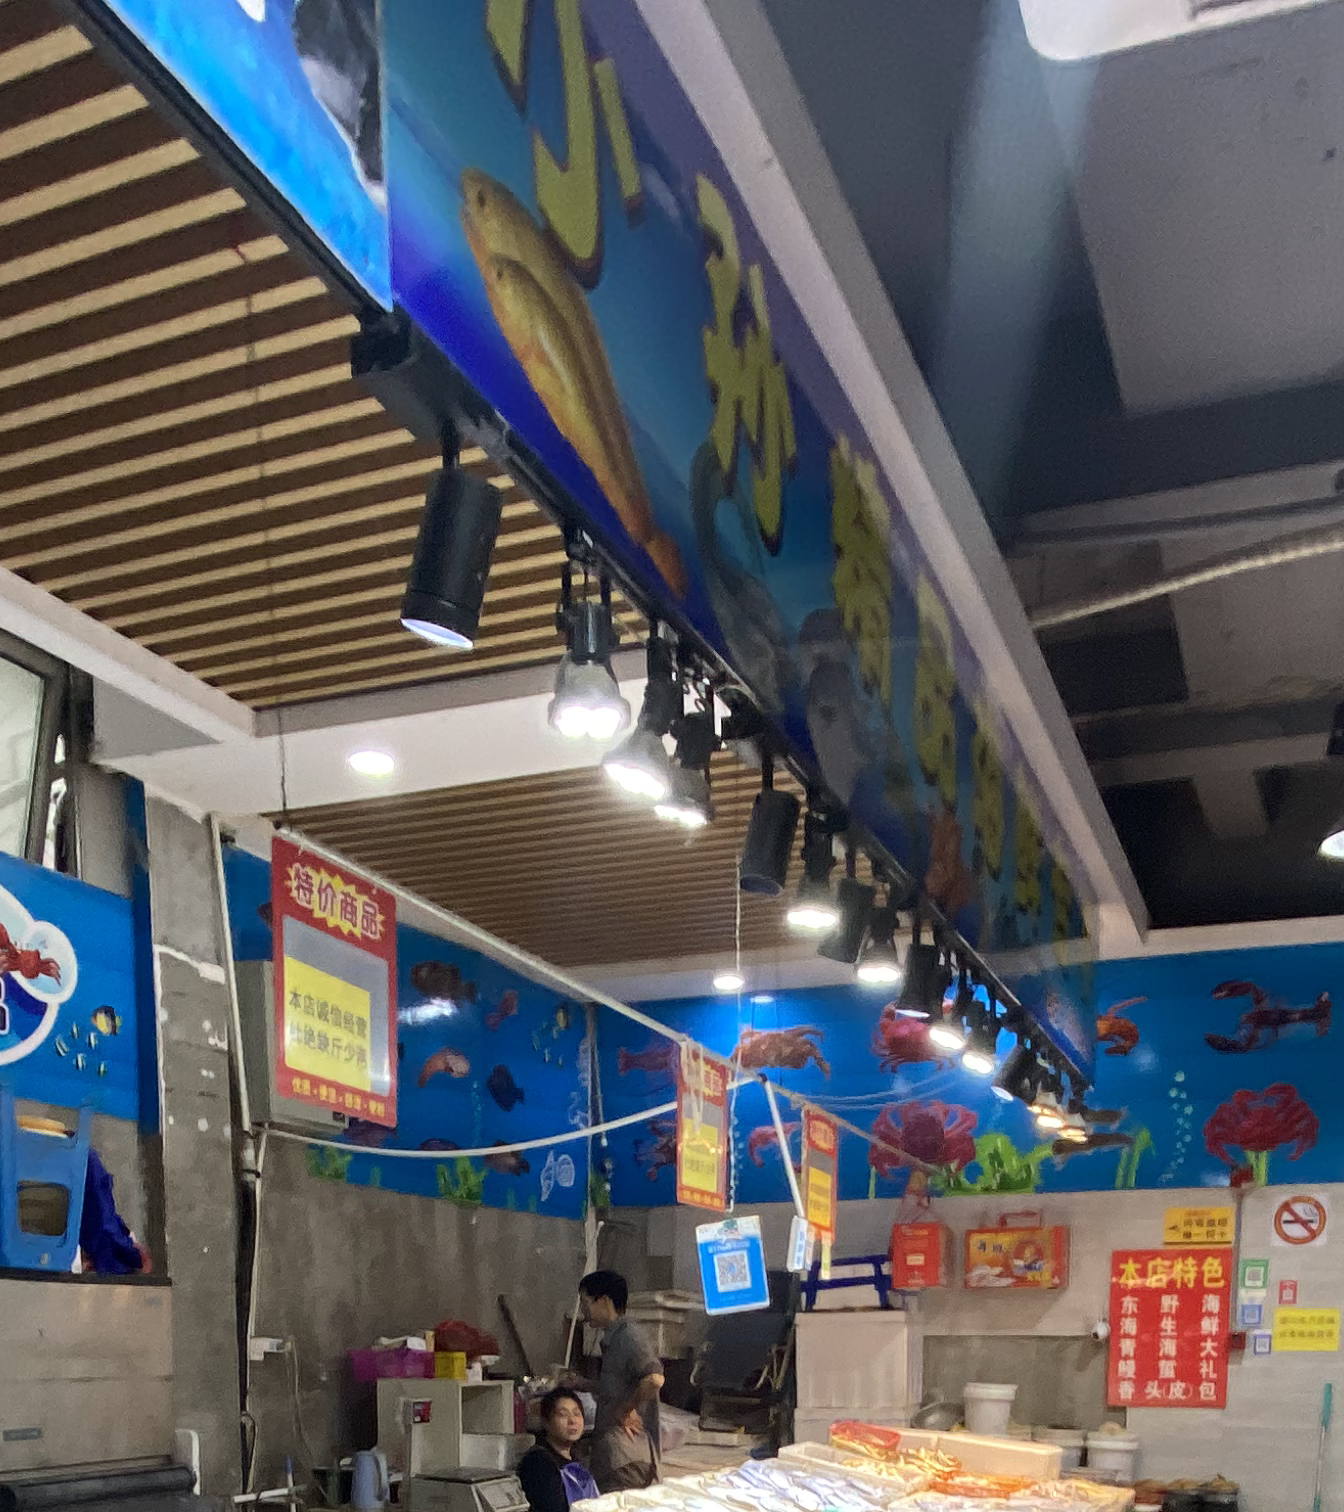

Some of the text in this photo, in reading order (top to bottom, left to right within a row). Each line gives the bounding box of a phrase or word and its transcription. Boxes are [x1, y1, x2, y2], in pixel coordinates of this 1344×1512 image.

[292, 860, 382, 941] 特价商品
[1118, 1255, 1226, 1290] 本店特色
[1198, 1293, 1221, 1401] 海鲜大礼包
